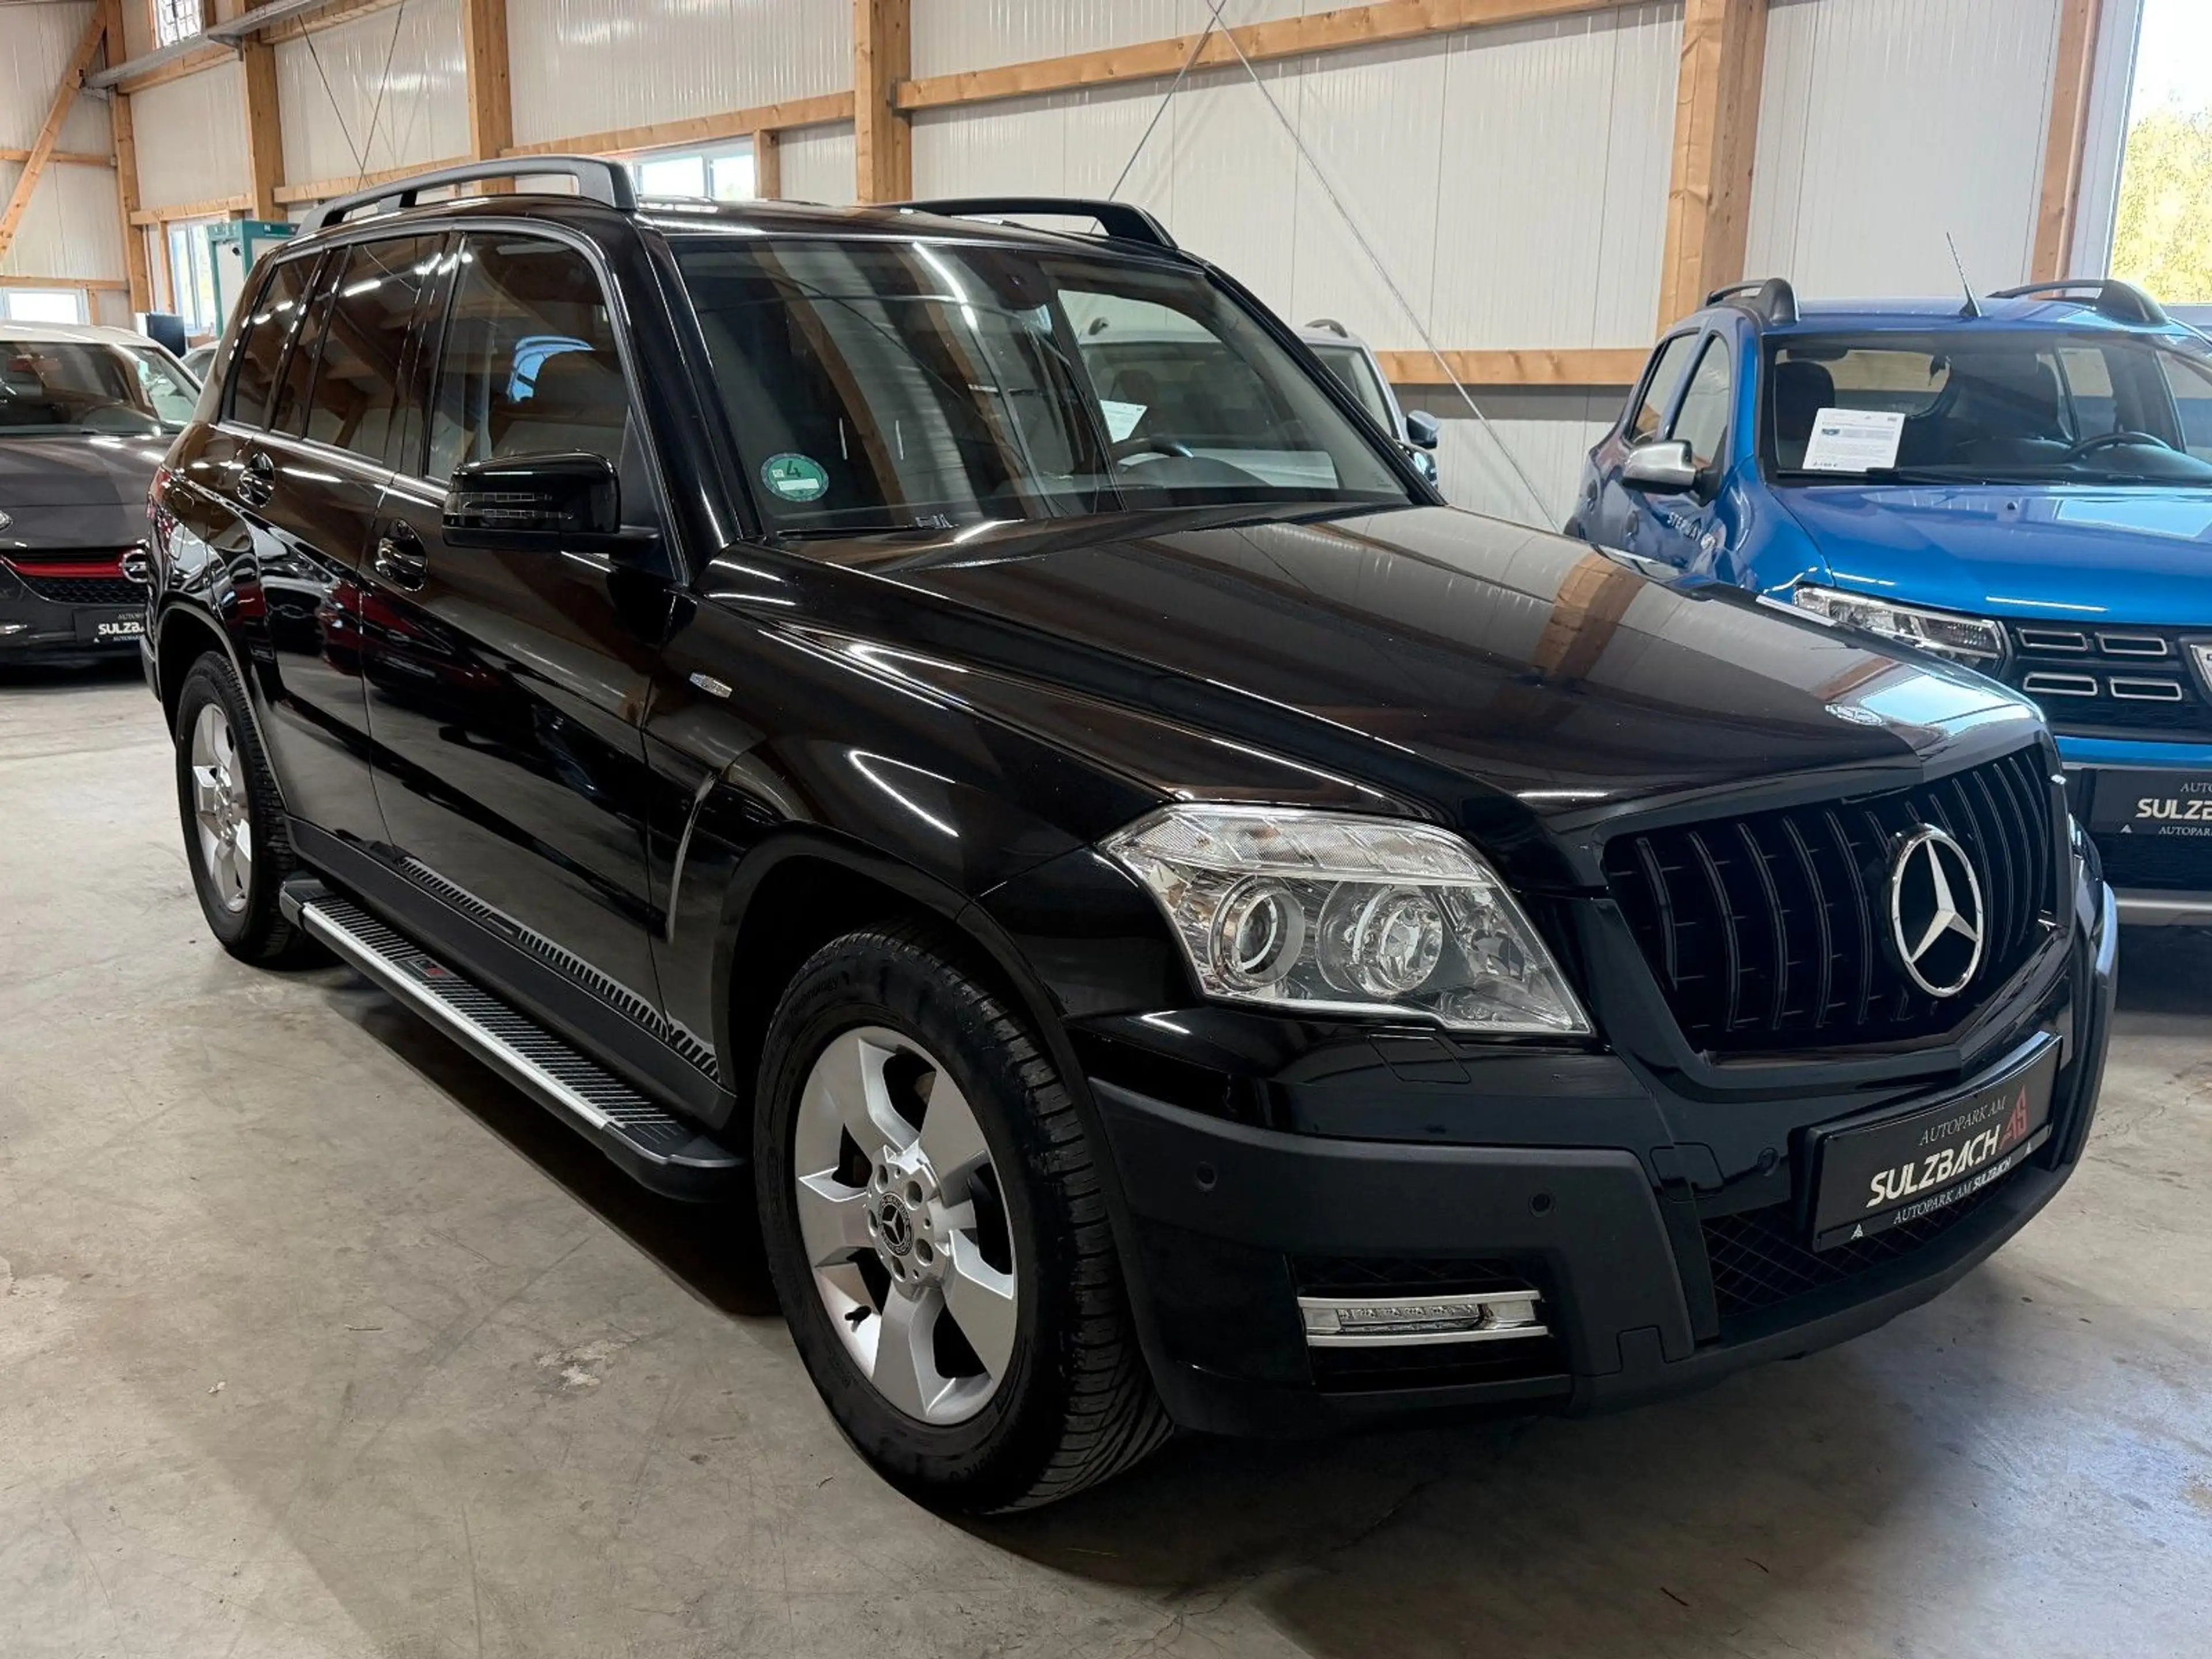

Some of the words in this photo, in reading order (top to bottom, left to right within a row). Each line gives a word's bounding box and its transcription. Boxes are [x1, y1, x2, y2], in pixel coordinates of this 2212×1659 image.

[786, 460, 801, 478] 4
[2158, 826, 2212, 836] AUTOPAR
[1919, 1104, 1988, 1146] AUTOPARK
[1988, 1095, 2007, 1118] AM
[1866, 1124, 2001, 1209] SULZBACH
[1893, 1189, 1955, 1225] AUTOPARK
[1955, 1181, 1972, 1200] AM
